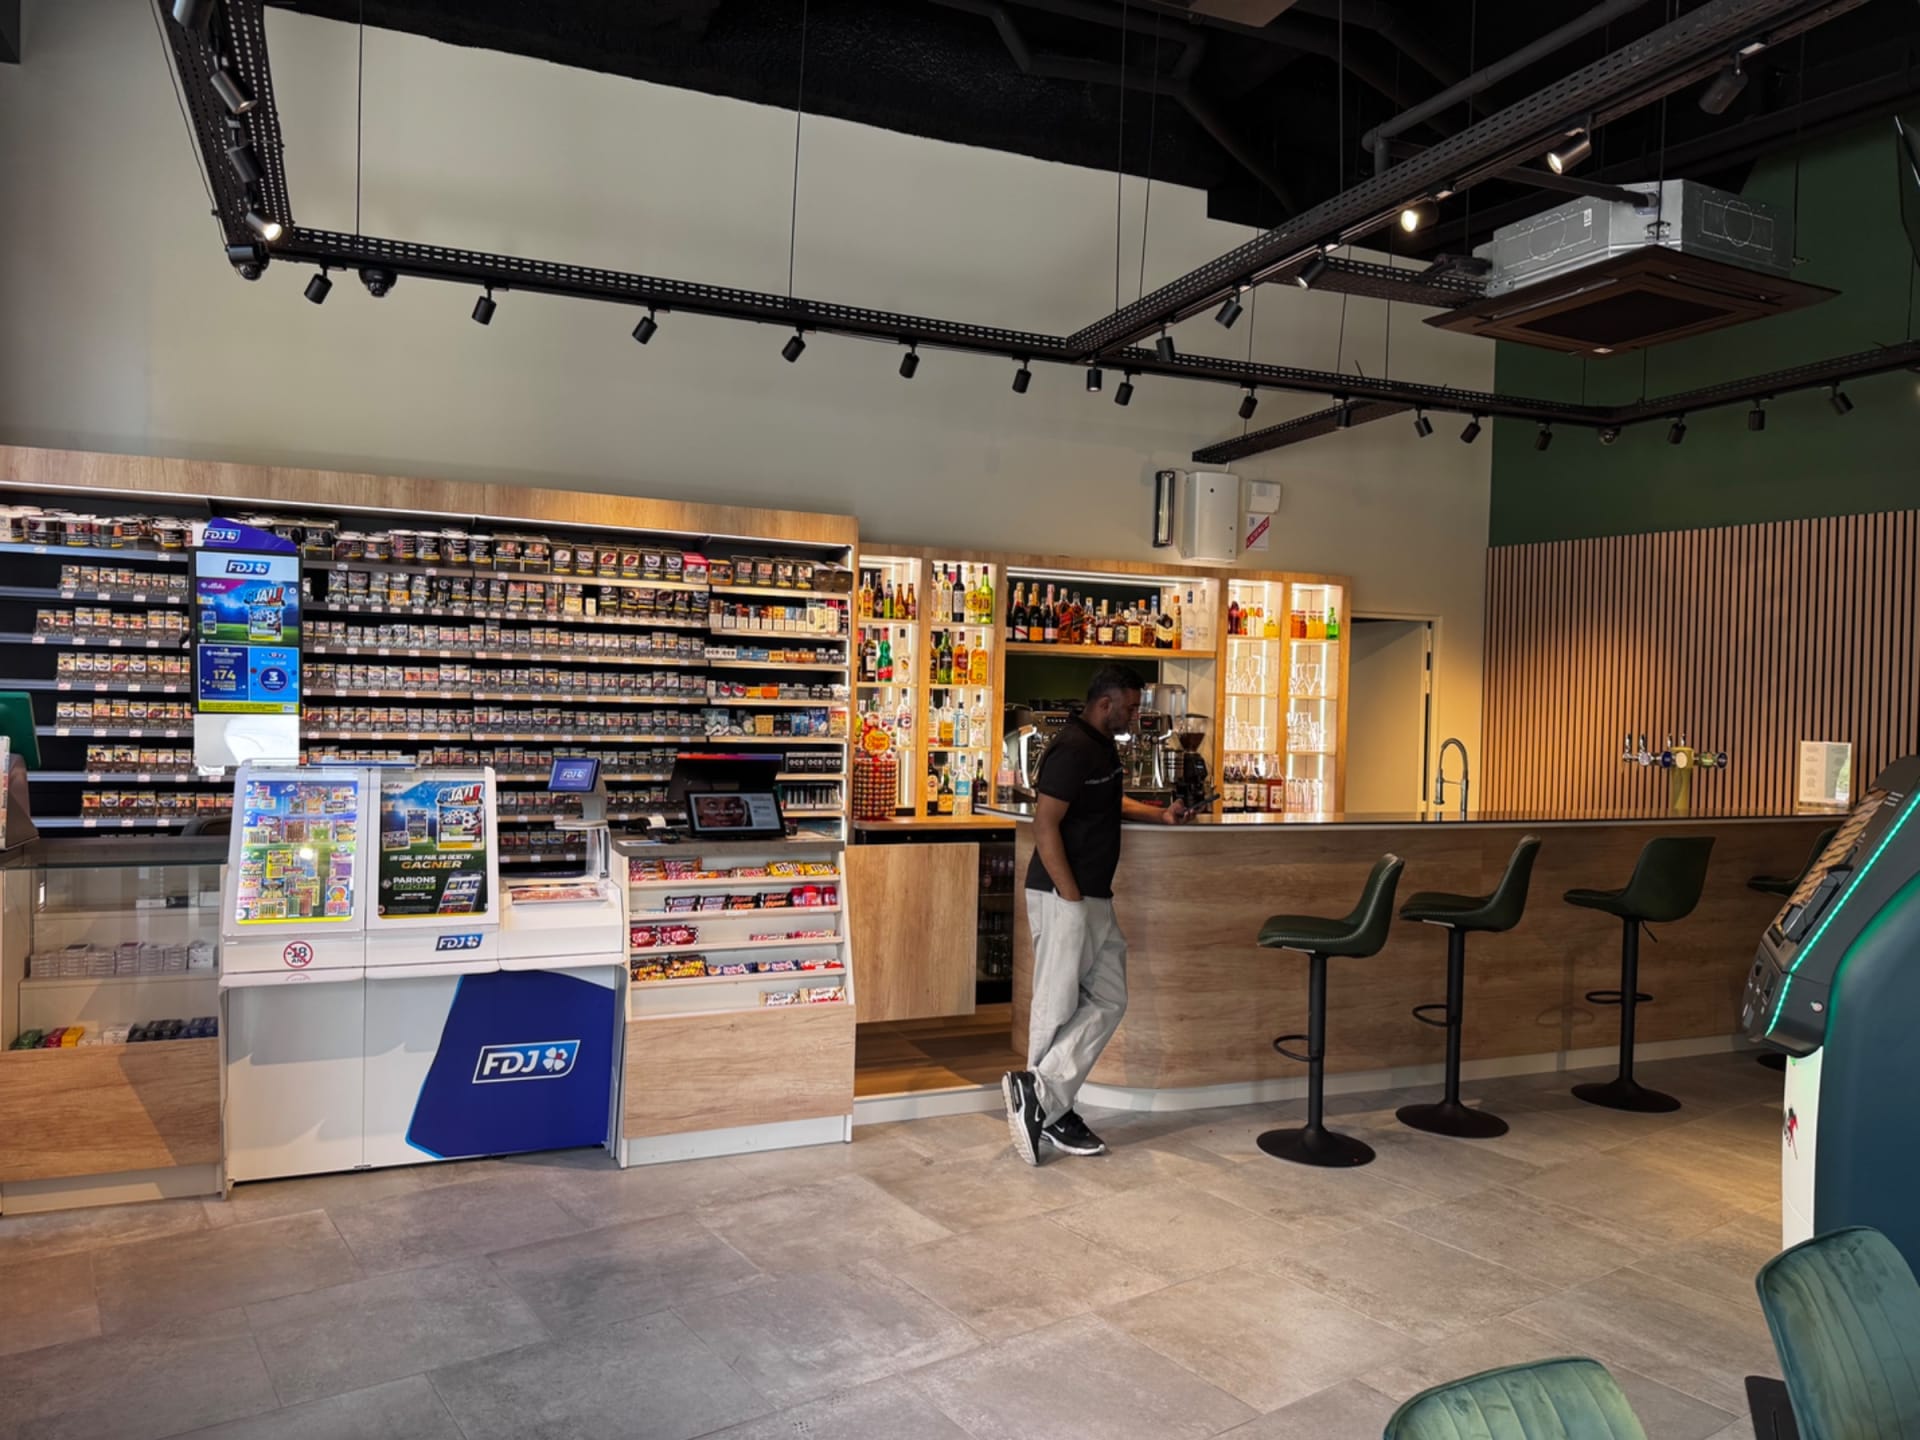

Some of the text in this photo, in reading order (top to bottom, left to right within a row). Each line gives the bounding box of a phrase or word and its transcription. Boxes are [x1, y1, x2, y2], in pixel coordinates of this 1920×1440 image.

[204, 530, 226, 541] FDJ
[228, 562, 254, 573] FDJ
[213, 670, 236, 680] 174
[268, 671, 279, 681] 3
[401, 860, 462, 869] GAGNER
[393, 875, 437, 884] PARIONS
[438, 937, 466, 949] FDJ
[482, 1050, 540, 1076] FDJ
